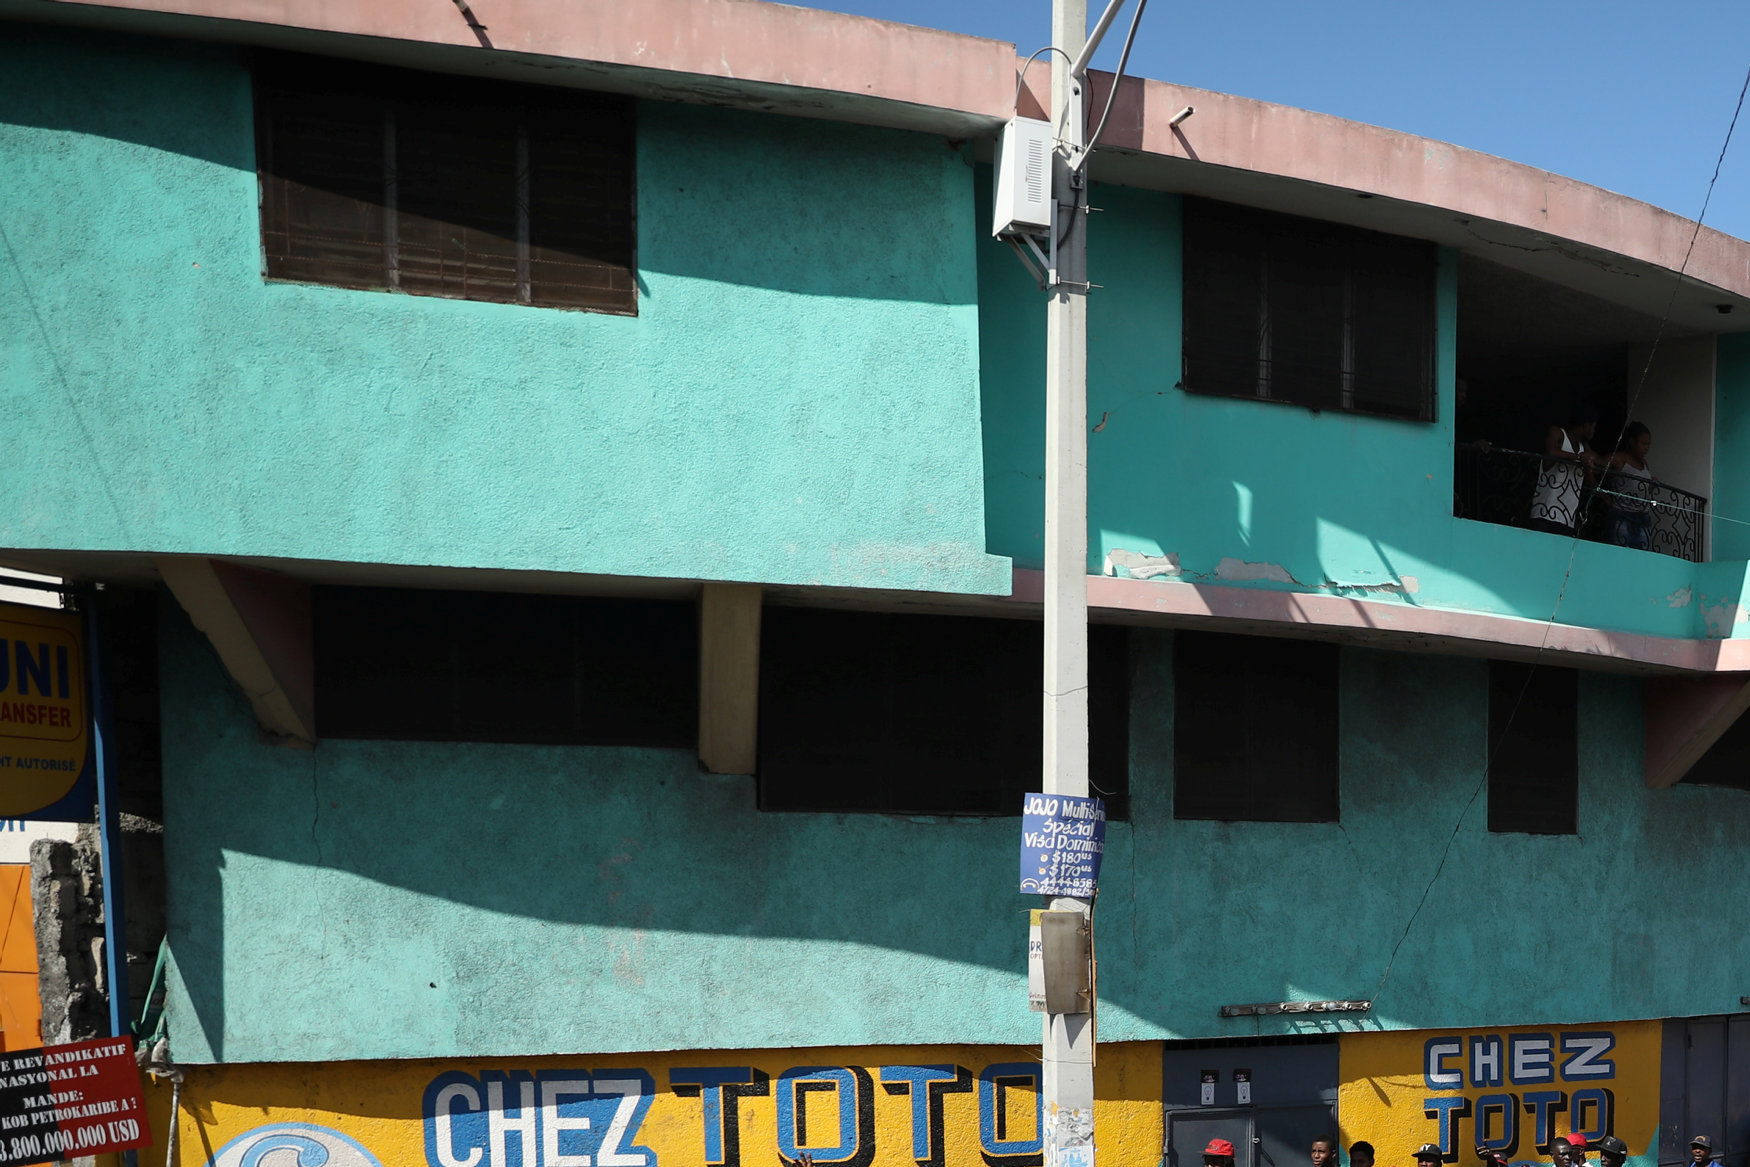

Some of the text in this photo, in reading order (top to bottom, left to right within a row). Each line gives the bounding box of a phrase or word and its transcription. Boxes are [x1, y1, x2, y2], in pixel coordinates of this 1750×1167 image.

[0, 702, 72, 728] ANSFER
[1023, 797, 1059, 816] JOJO
[13, 1043, 126, 1070] REVANDIKATIF
[1427, 1034, 1613, 1089] CHEZ
[80, 1064, 99, 1077] LA
[23, 1090, 84, 1109] MANDE:
[2, 1114, 29, 1130] KOB
[108, 1118, 140, 1144] USD
[1425, 1089, 1613, 1162] TOTO
